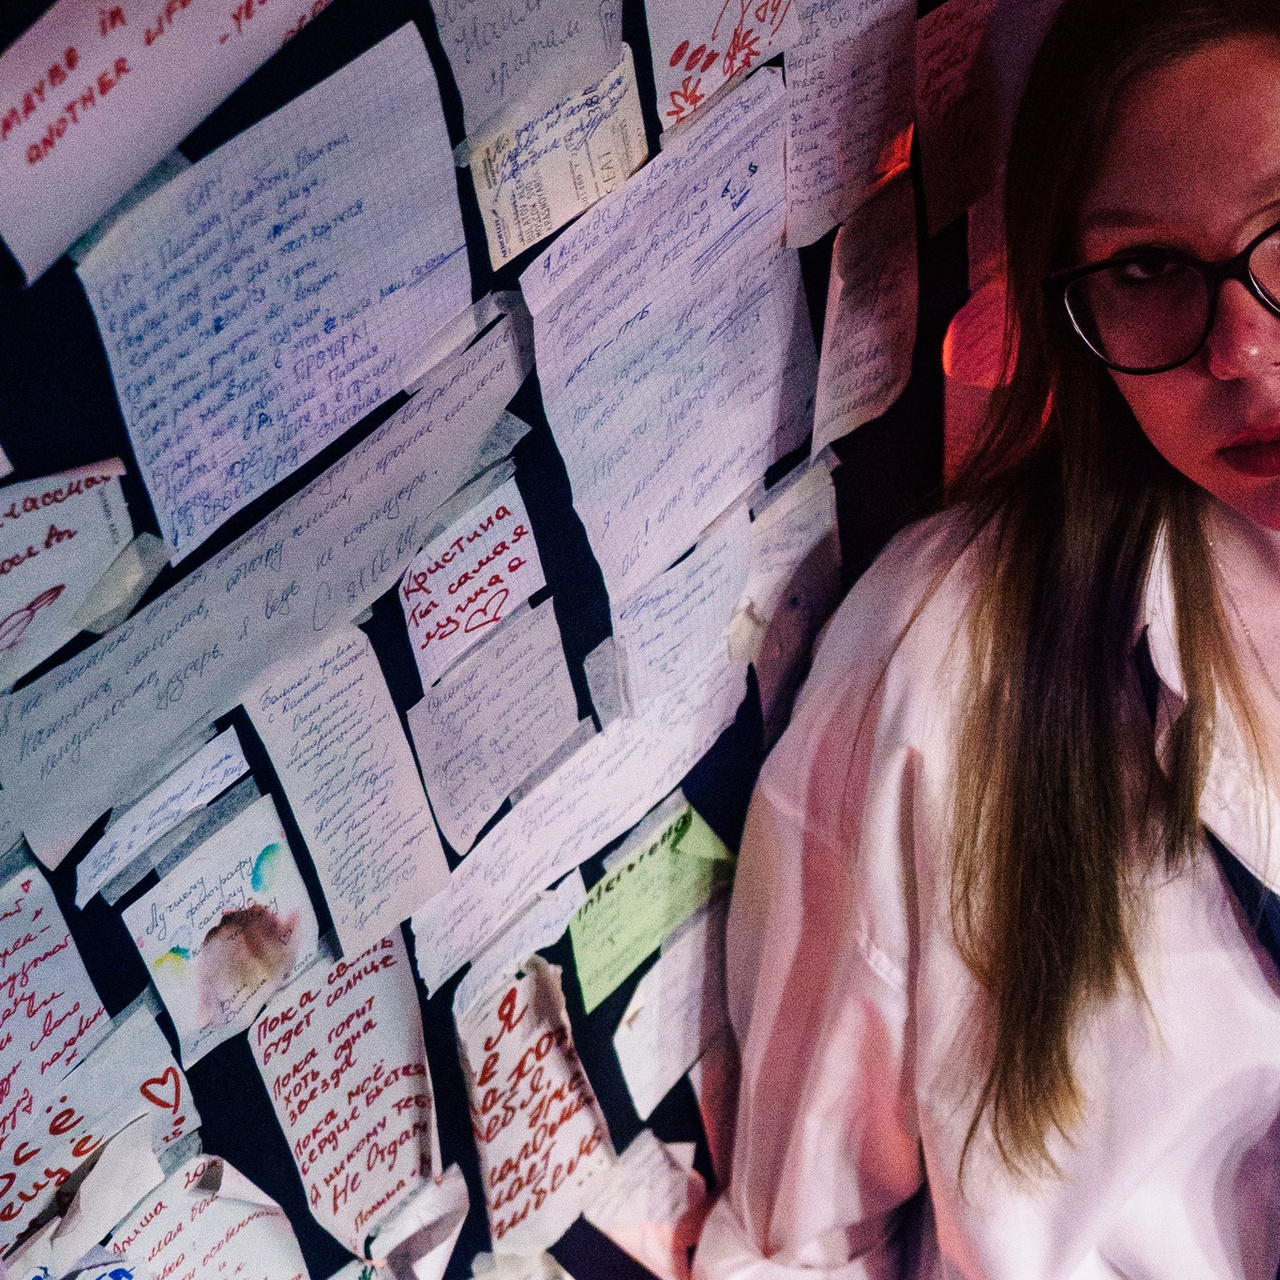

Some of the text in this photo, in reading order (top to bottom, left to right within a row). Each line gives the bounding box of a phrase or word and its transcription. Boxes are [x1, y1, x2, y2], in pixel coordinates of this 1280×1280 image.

[518, 202, 535, 243] BULATOV
[401, 506, 514, 599] Кристина
[444, 525, 527, 595] самая
[326, 954, 397, 1007] солнце
[254, 991, 319, 1041] Пока
[274, 996, 375, 1099] Пока горит
[329, 1019, 377, 1061] одна
[285, 1055, 361, 1124] звезда
[295, 1109, 341, 1154] Пока
[296, 1107, 367, 1175] сердце
[320, 1117, 393, 1185] никому
